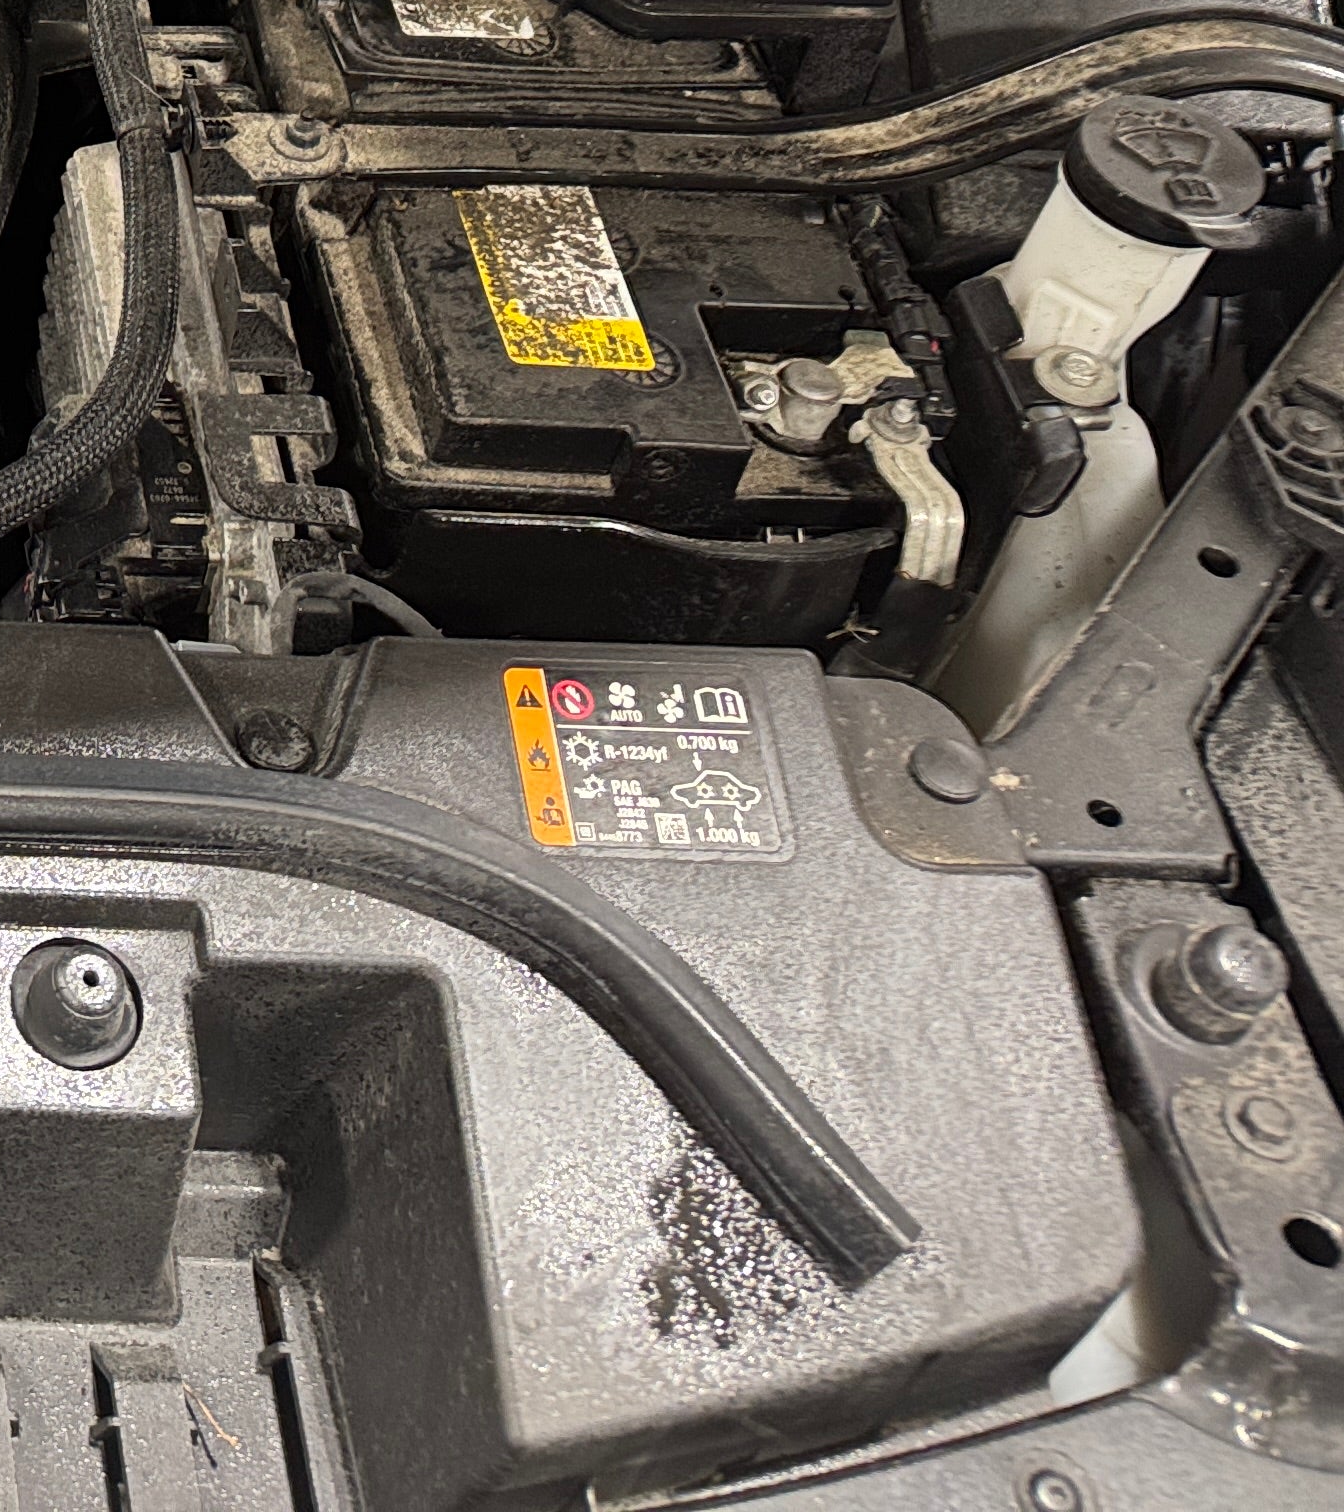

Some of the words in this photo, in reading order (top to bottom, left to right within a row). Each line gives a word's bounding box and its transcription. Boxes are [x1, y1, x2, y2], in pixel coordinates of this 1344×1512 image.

[610, 709, 643, 723] AUTO
[676, 735, 717, 751] 0.700
[718, 736, 739, 754] kg
[603, 744, 669, 763] R-1234yf
[610, 779, 643, 795] PAG
[613, 795, 635, 807] SAE
[695, 826, 738, 843] 1.000
[739, 828, 761, 847] kg
